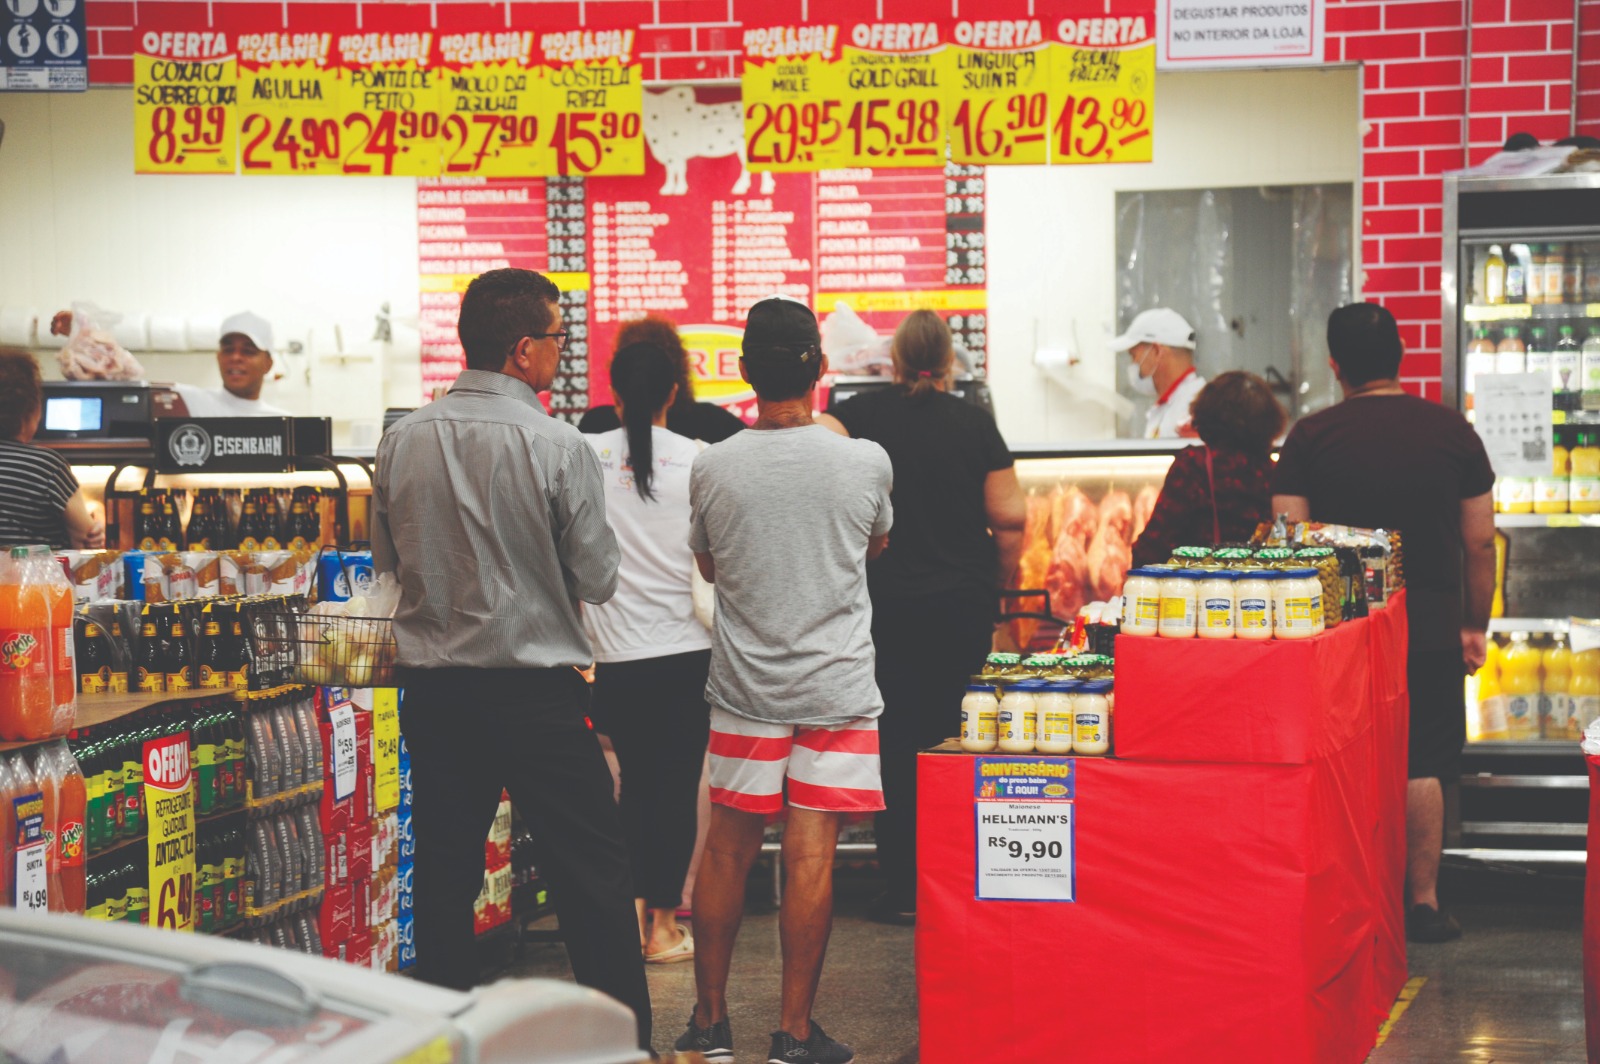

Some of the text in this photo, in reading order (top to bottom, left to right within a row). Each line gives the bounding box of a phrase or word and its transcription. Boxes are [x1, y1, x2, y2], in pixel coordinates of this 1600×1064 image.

[1174, 4, 1308, 20] DEGUSTAR PRODUTOS
[852, 23, 939, 50] OFERTA
[954, 20, 1042, 47] OFERTA
[1057, 17, 1146, 45] OFERTA
[1174, 30, 1191, 41] NO
[1195, 29, 1249, 41] INTERIOR
[1253, 28, 1270, 39] DA
[143, 32, 227, 57] OFERTA
[253, 78, 322, 100] AGULHA
[352, 70, 432, 88] PONTA DE
[849, 69, 939, 90] GOLD GRILL
[364, 92, 414, 110] PEITO
[953, 92, 1047, 158] 16,90
[1053, 95, 1146, 160] 13,90
[149, 741, 189, 783] OFERTA
[981, 761, 1069, 778] ANIVERSÁRIO
[1015, 786, 1039, 794] AQUI!
[982, 815, 1068, 824] HELLMANN'S
[988, 836, 1062, 862] R$ 9,90
[27, 859, 43, 872] SUKITA
